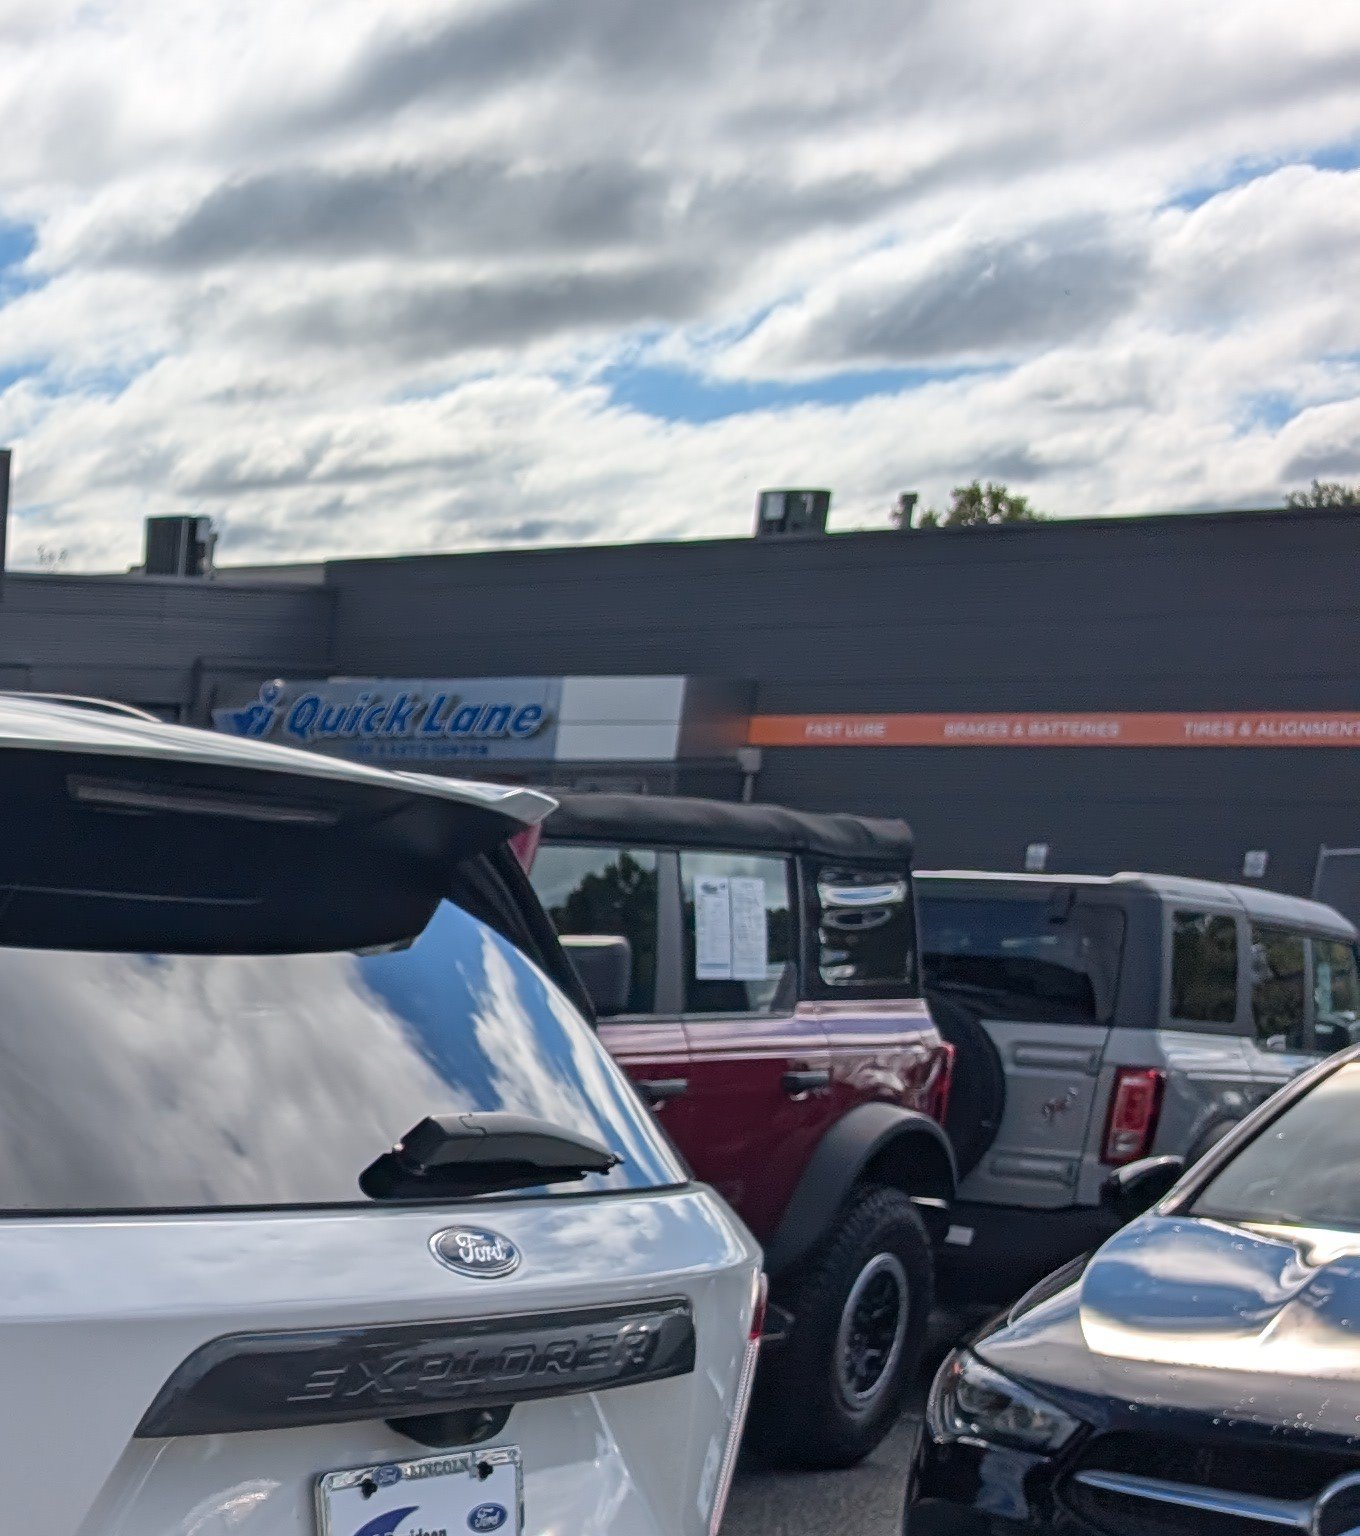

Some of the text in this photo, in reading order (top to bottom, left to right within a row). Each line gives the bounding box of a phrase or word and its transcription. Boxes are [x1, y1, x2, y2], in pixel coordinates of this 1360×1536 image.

[287, 691, 546, 741] Quick Lane
[943, 720, 1009, 738] BRAKES
[1027, 720, 1121, 738] BATTERIES
[1184, 721, 1235, 738] TIRES
[285, 1325, 652, 1402] EXPLORER
